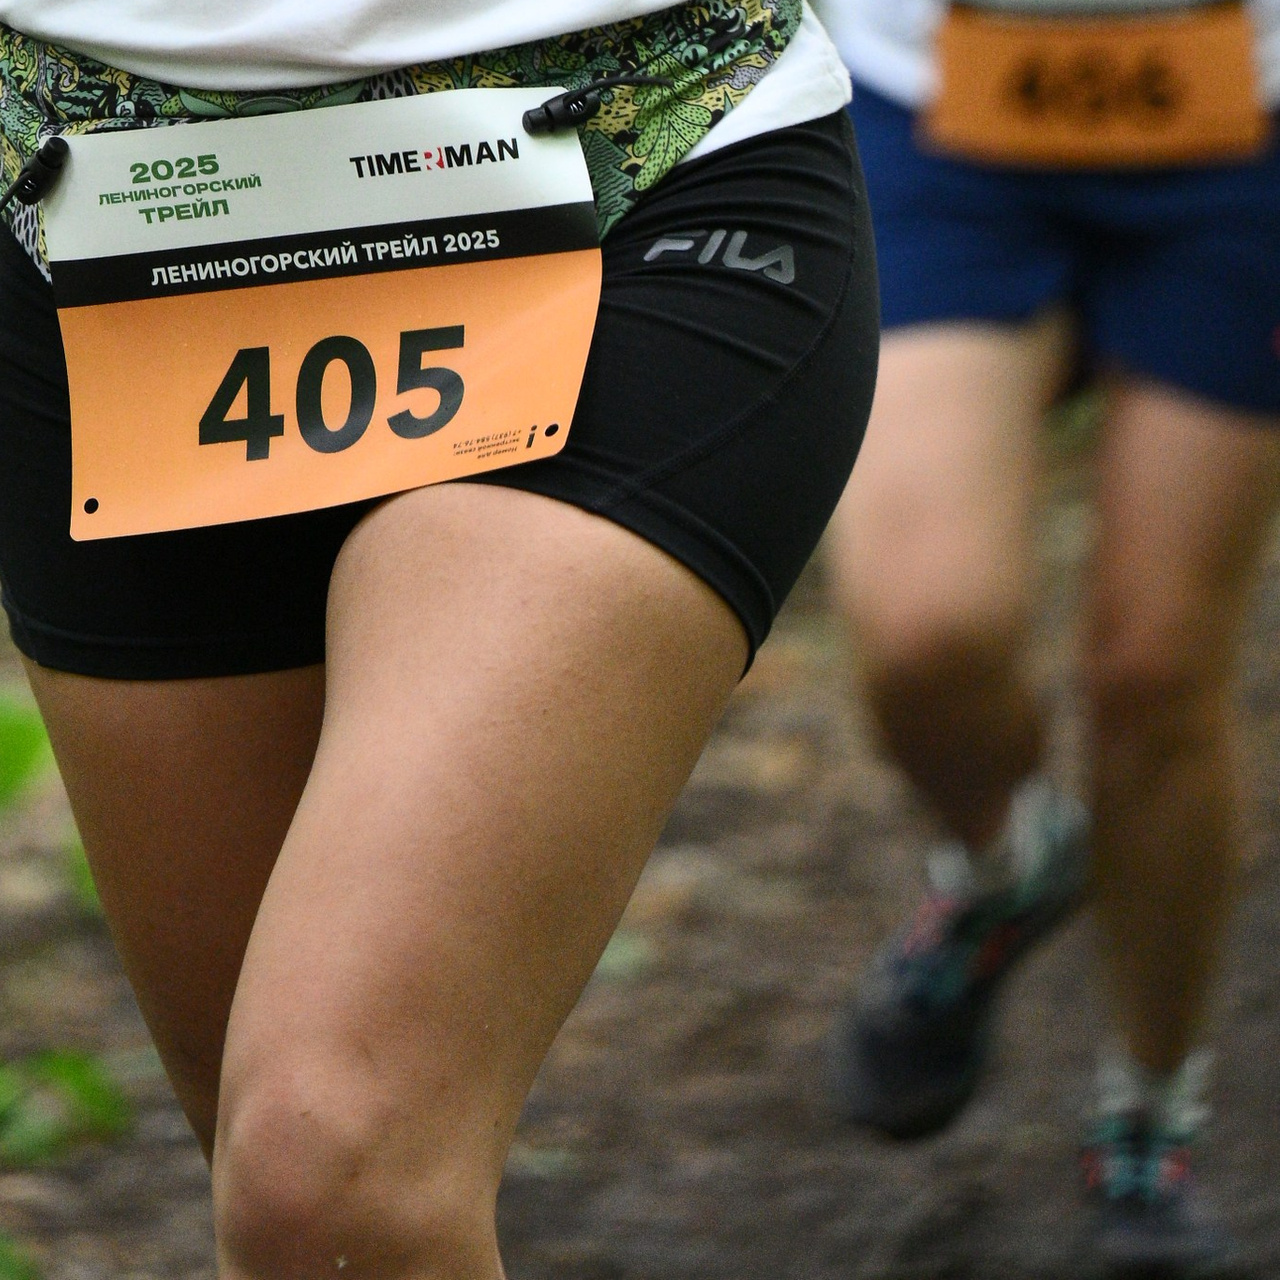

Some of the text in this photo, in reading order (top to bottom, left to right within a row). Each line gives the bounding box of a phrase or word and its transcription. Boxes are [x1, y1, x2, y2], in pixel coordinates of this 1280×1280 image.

[99, 173, 262, 206] ЛЕНИНОГОРСКИЙ
[130, 154, 220, 184] 2025
[139, 198, 230, 224] ТРЕЙЛ
[151, 229, 500, 286] ЛЕНИНОГОРСКИЙ ТРЕЙЛ 2025
[643, 229, 795, 284] FILA
[199, 324, 465, 462] 405
